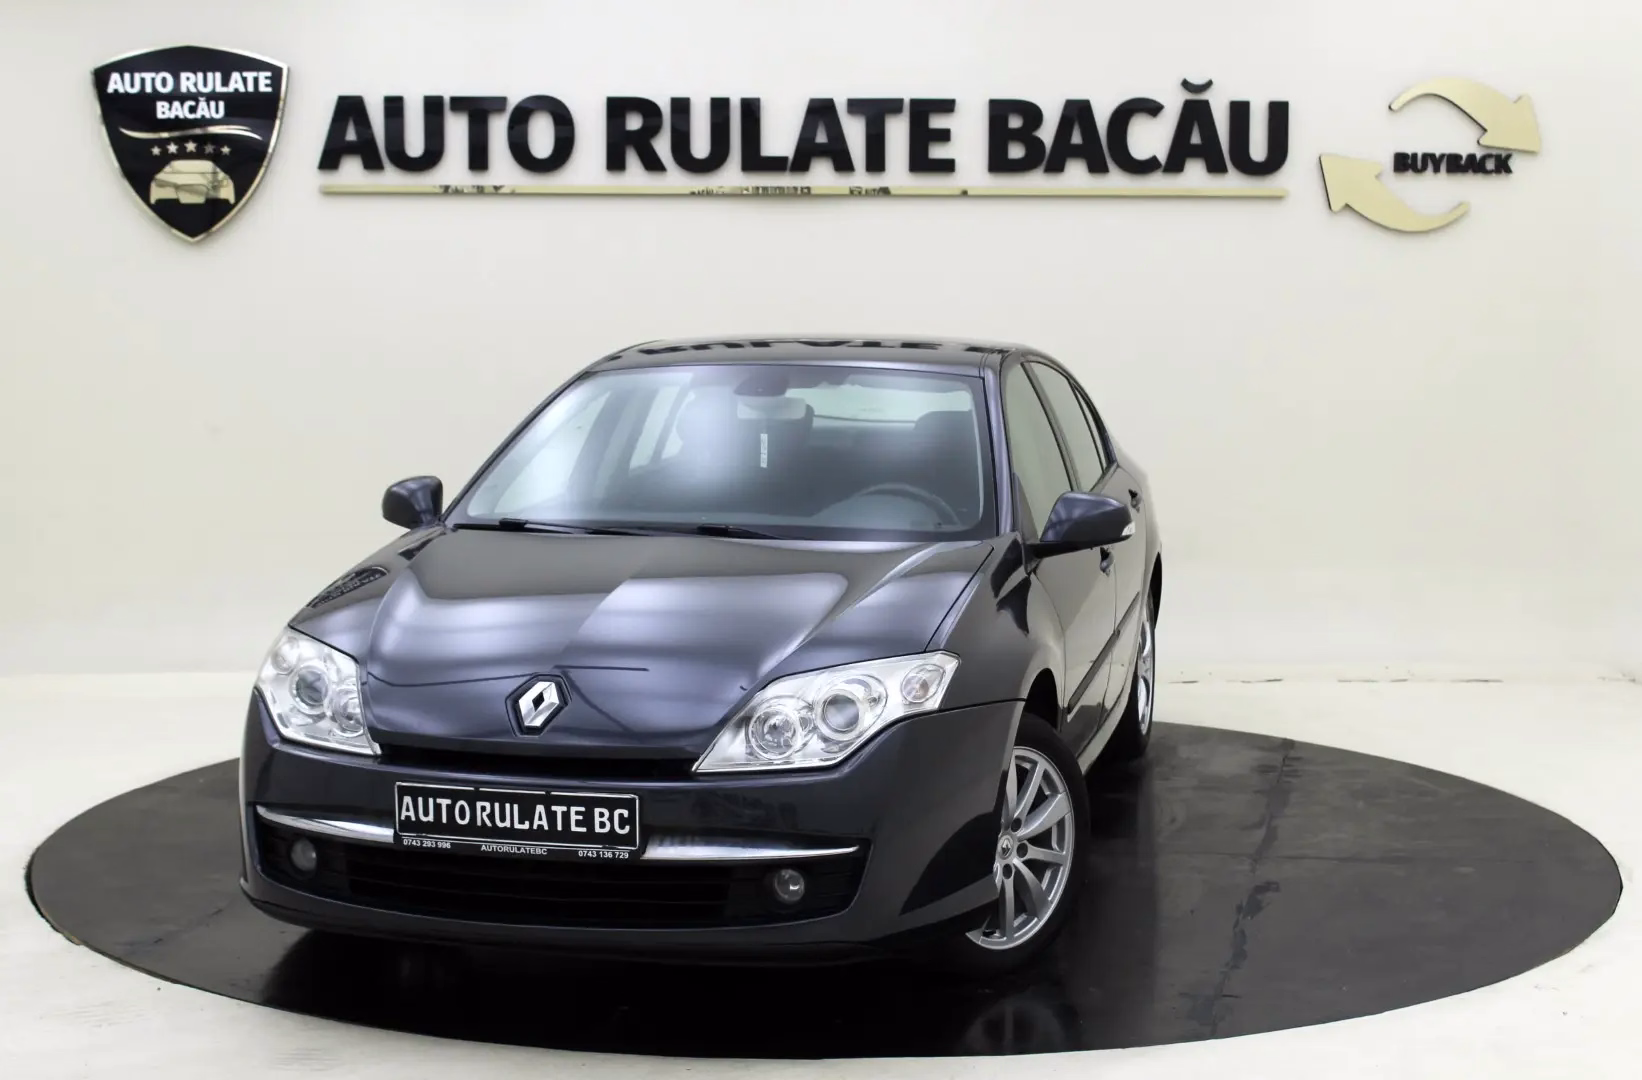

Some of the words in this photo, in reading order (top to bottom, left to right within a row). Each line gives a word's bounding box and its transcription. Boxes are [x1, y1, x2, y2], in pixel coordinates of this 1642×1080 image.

[107, 72, 174, 94] AUTO
[180, 72, 272, 93] RULATE
[156, 97, 225, 120] BACĂU
[318, 95, 575, 173] AUTO
[606, 97, 956, 173] RULATE
[988, 79, 1289, 176] BACĂU
[1393, 152, 1513, 174] BUYBACK
[400, 795, 471, 825] AUTO
[476, 801, 587, 832] RULATE
[594, 807, 630, 834] BC
[403, 839, 421, 847] 0743
[422, 840, 436, 848] 293
[480, 844, 548, 854] AUTORULATEBC
[578, 850, 597, 858] 0743
[599, 851, 613, 859] 136
[614, 851, 629, 859] 729
